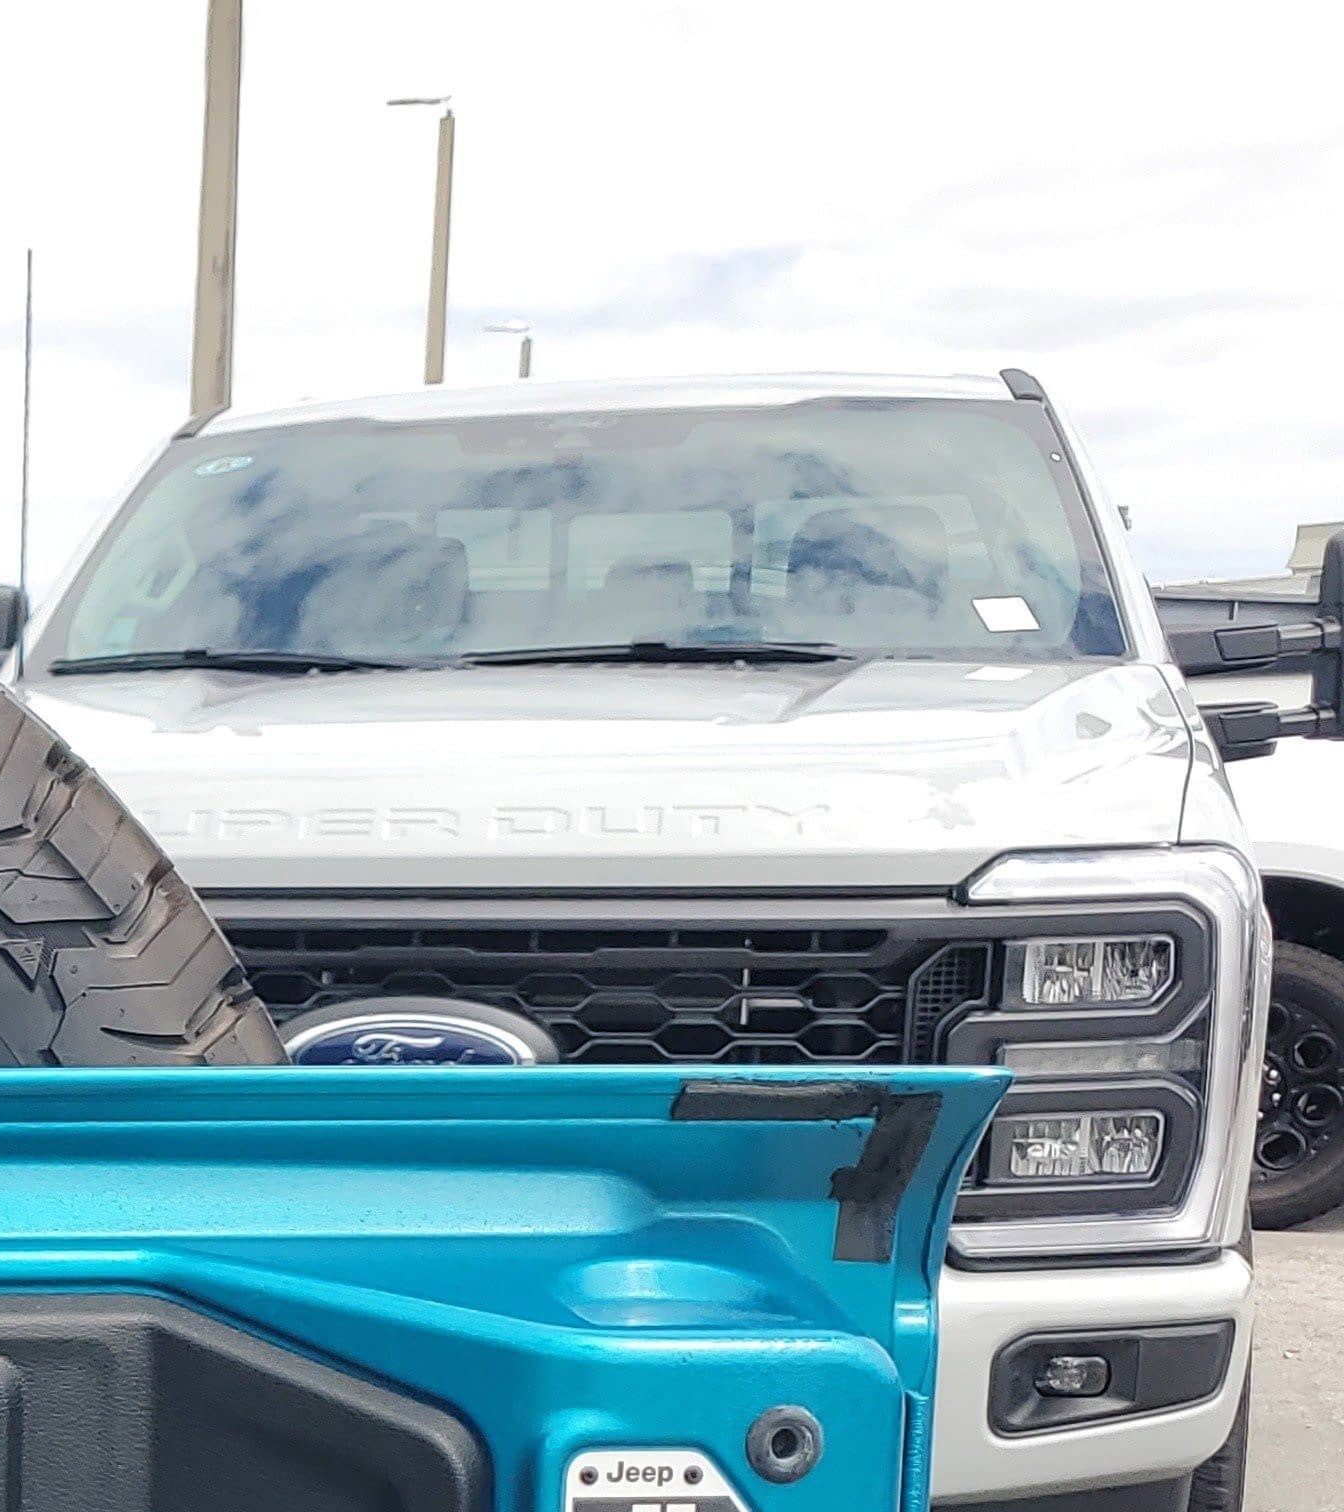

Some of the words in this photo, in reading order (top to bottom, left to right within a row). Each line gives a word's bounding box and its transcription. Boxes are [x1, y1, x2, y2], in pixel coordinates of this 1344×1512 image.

[139, 804, 462, 842] UPER
[487, 802, 833, 840] DUTY
[606, 1461, 674, 1486] Jeep
